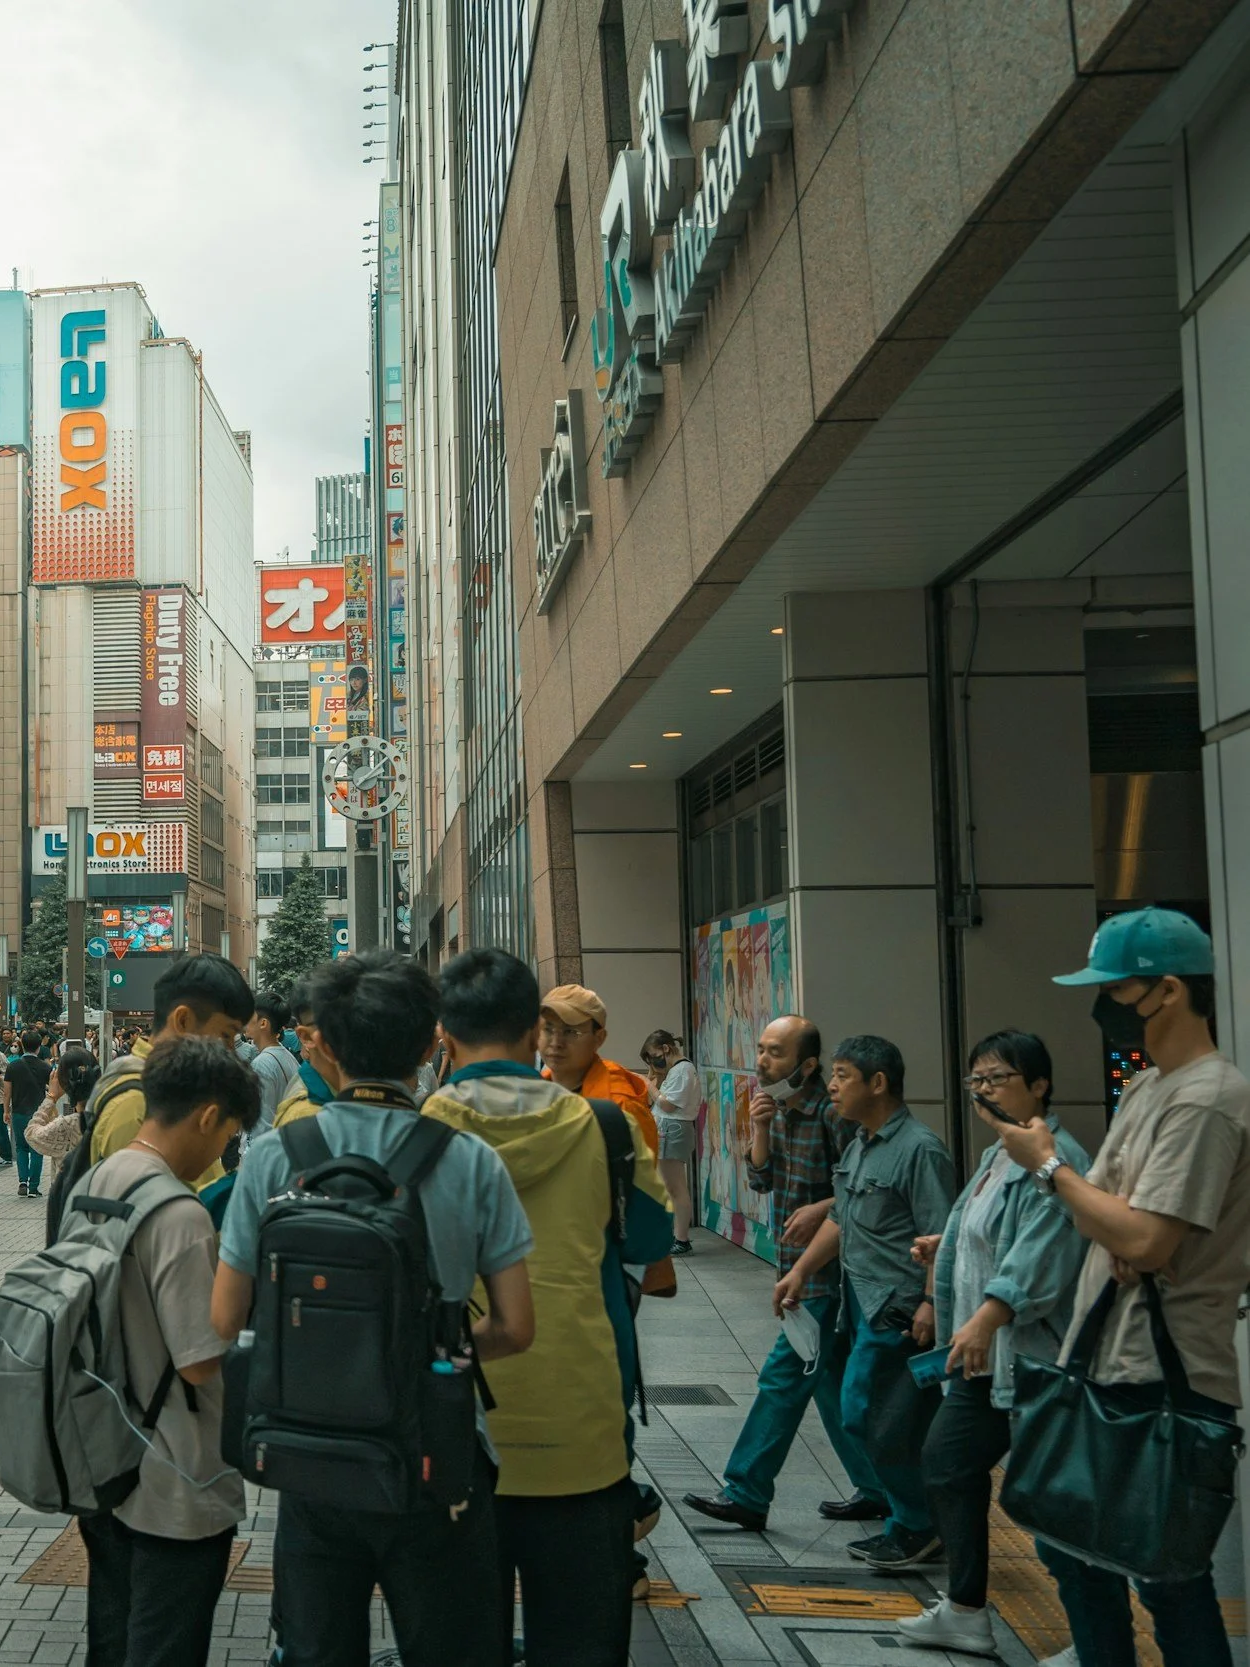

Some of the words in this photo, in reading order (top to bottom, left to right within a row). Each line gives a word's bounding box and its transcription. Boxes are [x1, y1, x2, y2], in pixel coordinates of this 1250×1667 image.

[144, 595, 157, 645] Flagship
[156, 594, 182, 649] Duty
[146, 647, 157, 681] Store
[158, 653, 183, 706] Free
[95, 724, 115, 736] 本店
[94, 735, 136, 748] 総合家電
[147, 749, 181, 767] 免税
[146, 779, 182, 794] 면세점
[123, 859, 147, 868] Store
[353, 1088, 385, 1100] Nikon
